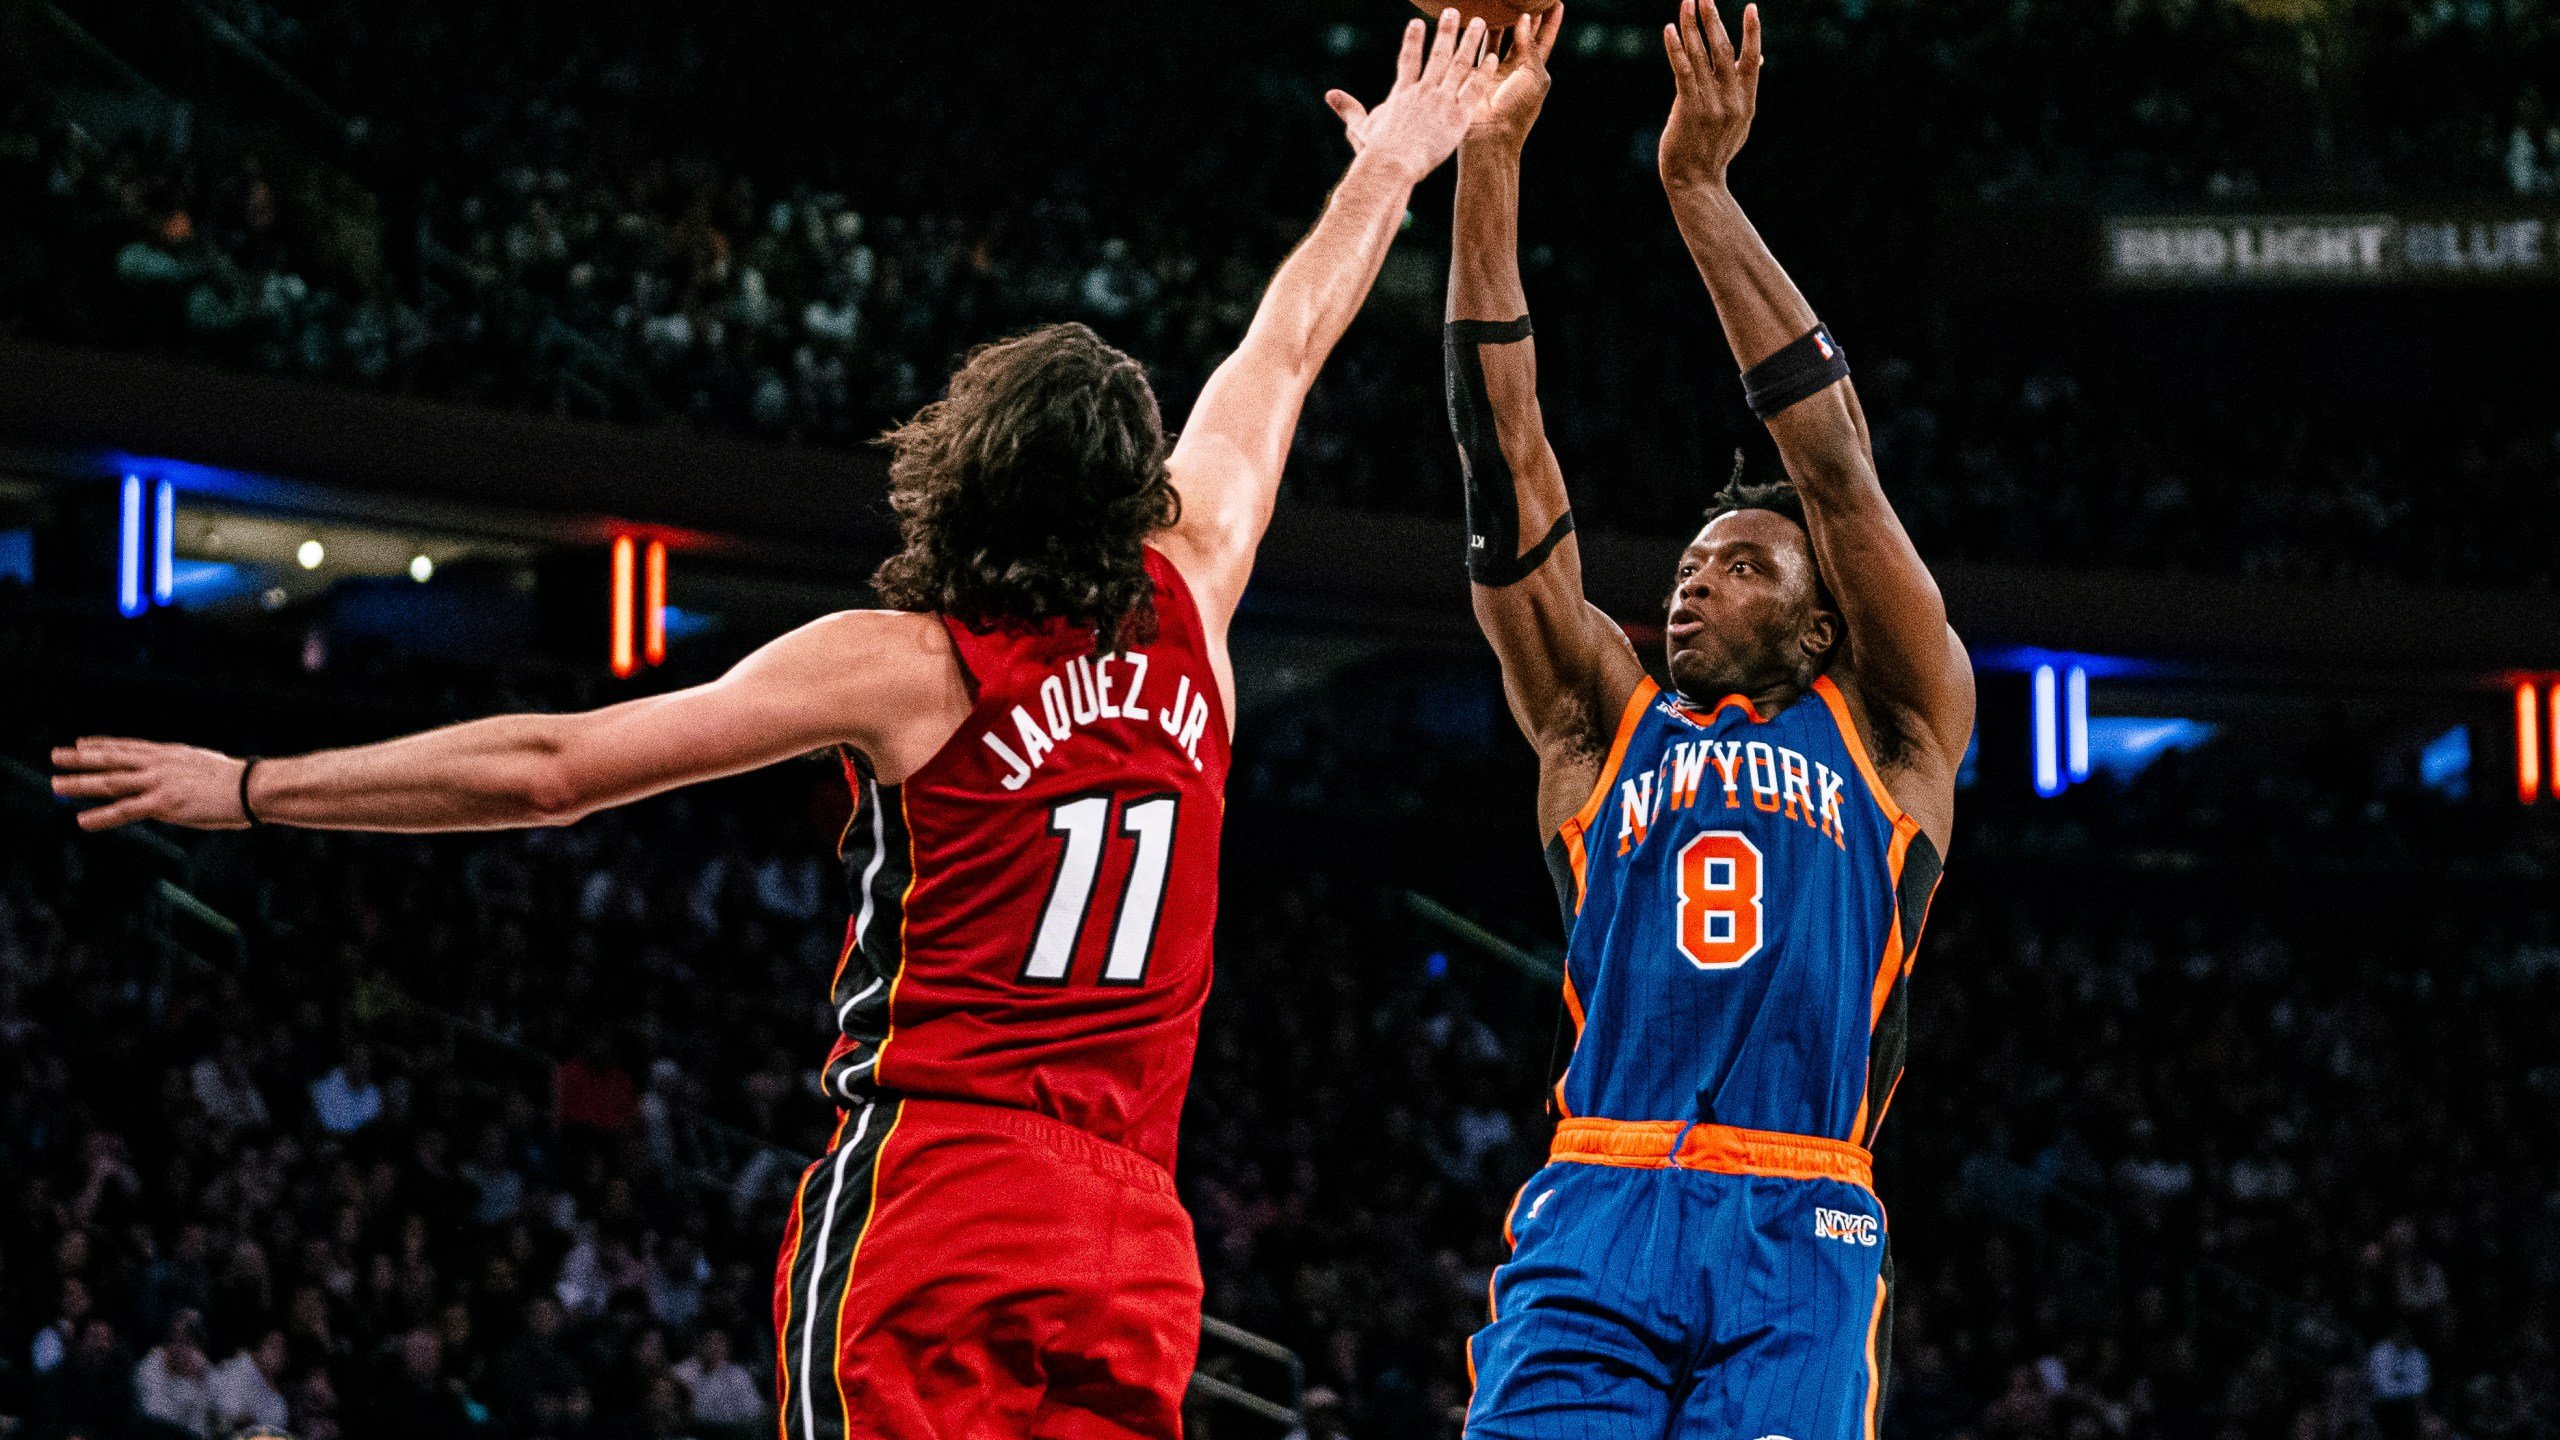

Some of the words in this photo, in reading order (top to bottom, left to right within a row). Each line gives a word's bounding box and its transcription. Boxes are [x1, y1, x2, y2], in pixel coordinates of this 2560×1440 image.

[2114, 226, 2226, 273] BUD
[2233, 225, 2385, 267] LIGHT
[2405, 219, 2540, 270] BLUE
[982, 651, 1149, 791] JAQUEZ
[1159, 675, 1208, 772] JR.
[1712, 740, 1846, 851] YORK
[1015, 791, 1182, 987] 11
[1676, 830, 1763, 970] 8
[1815, 1207, 1878, 1247] NYC
